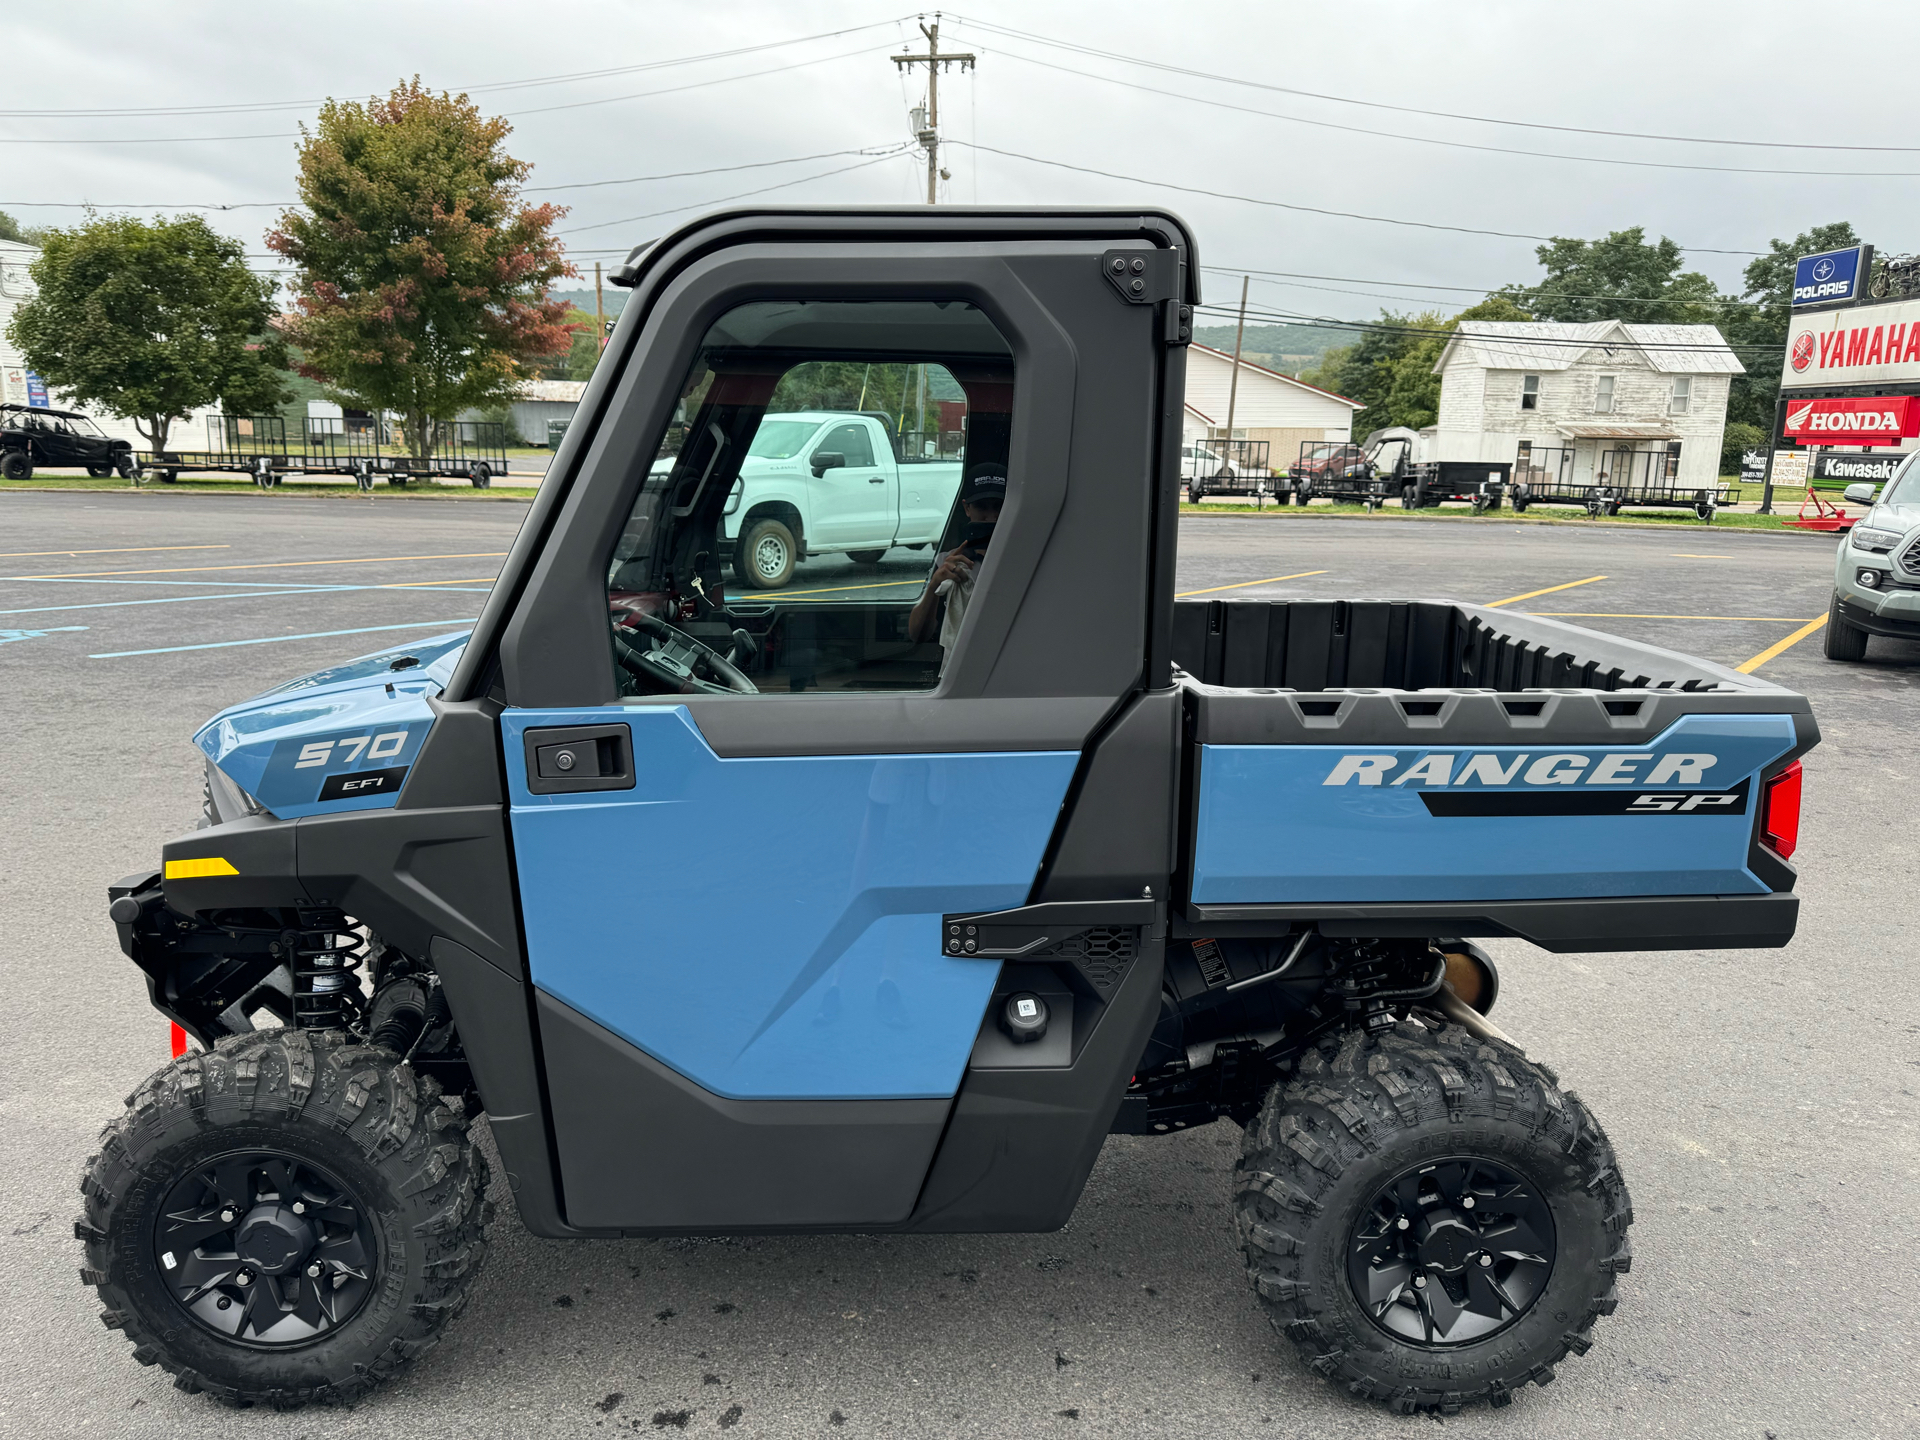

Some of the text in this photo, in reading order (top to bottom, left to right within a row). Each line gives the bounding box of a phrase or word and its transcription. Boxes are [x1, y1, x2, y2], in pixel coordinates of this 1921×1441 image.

[1794, 281, 1848, 301] POLARIS
[1819, 321, 1920, 369] YAMAHA
[1809, 411, 1900, 431] HONDA
[1824, 458, 1898, 479] Kawasaki
[294, 731, 409, 770] 570
[1321, 753, 1718, 787] RANGER
[341, 777, 384, 791] EFI
[1625, 794, 1741, 812] SP
[355, 1209, 408, 1348] X-TERRAIN
